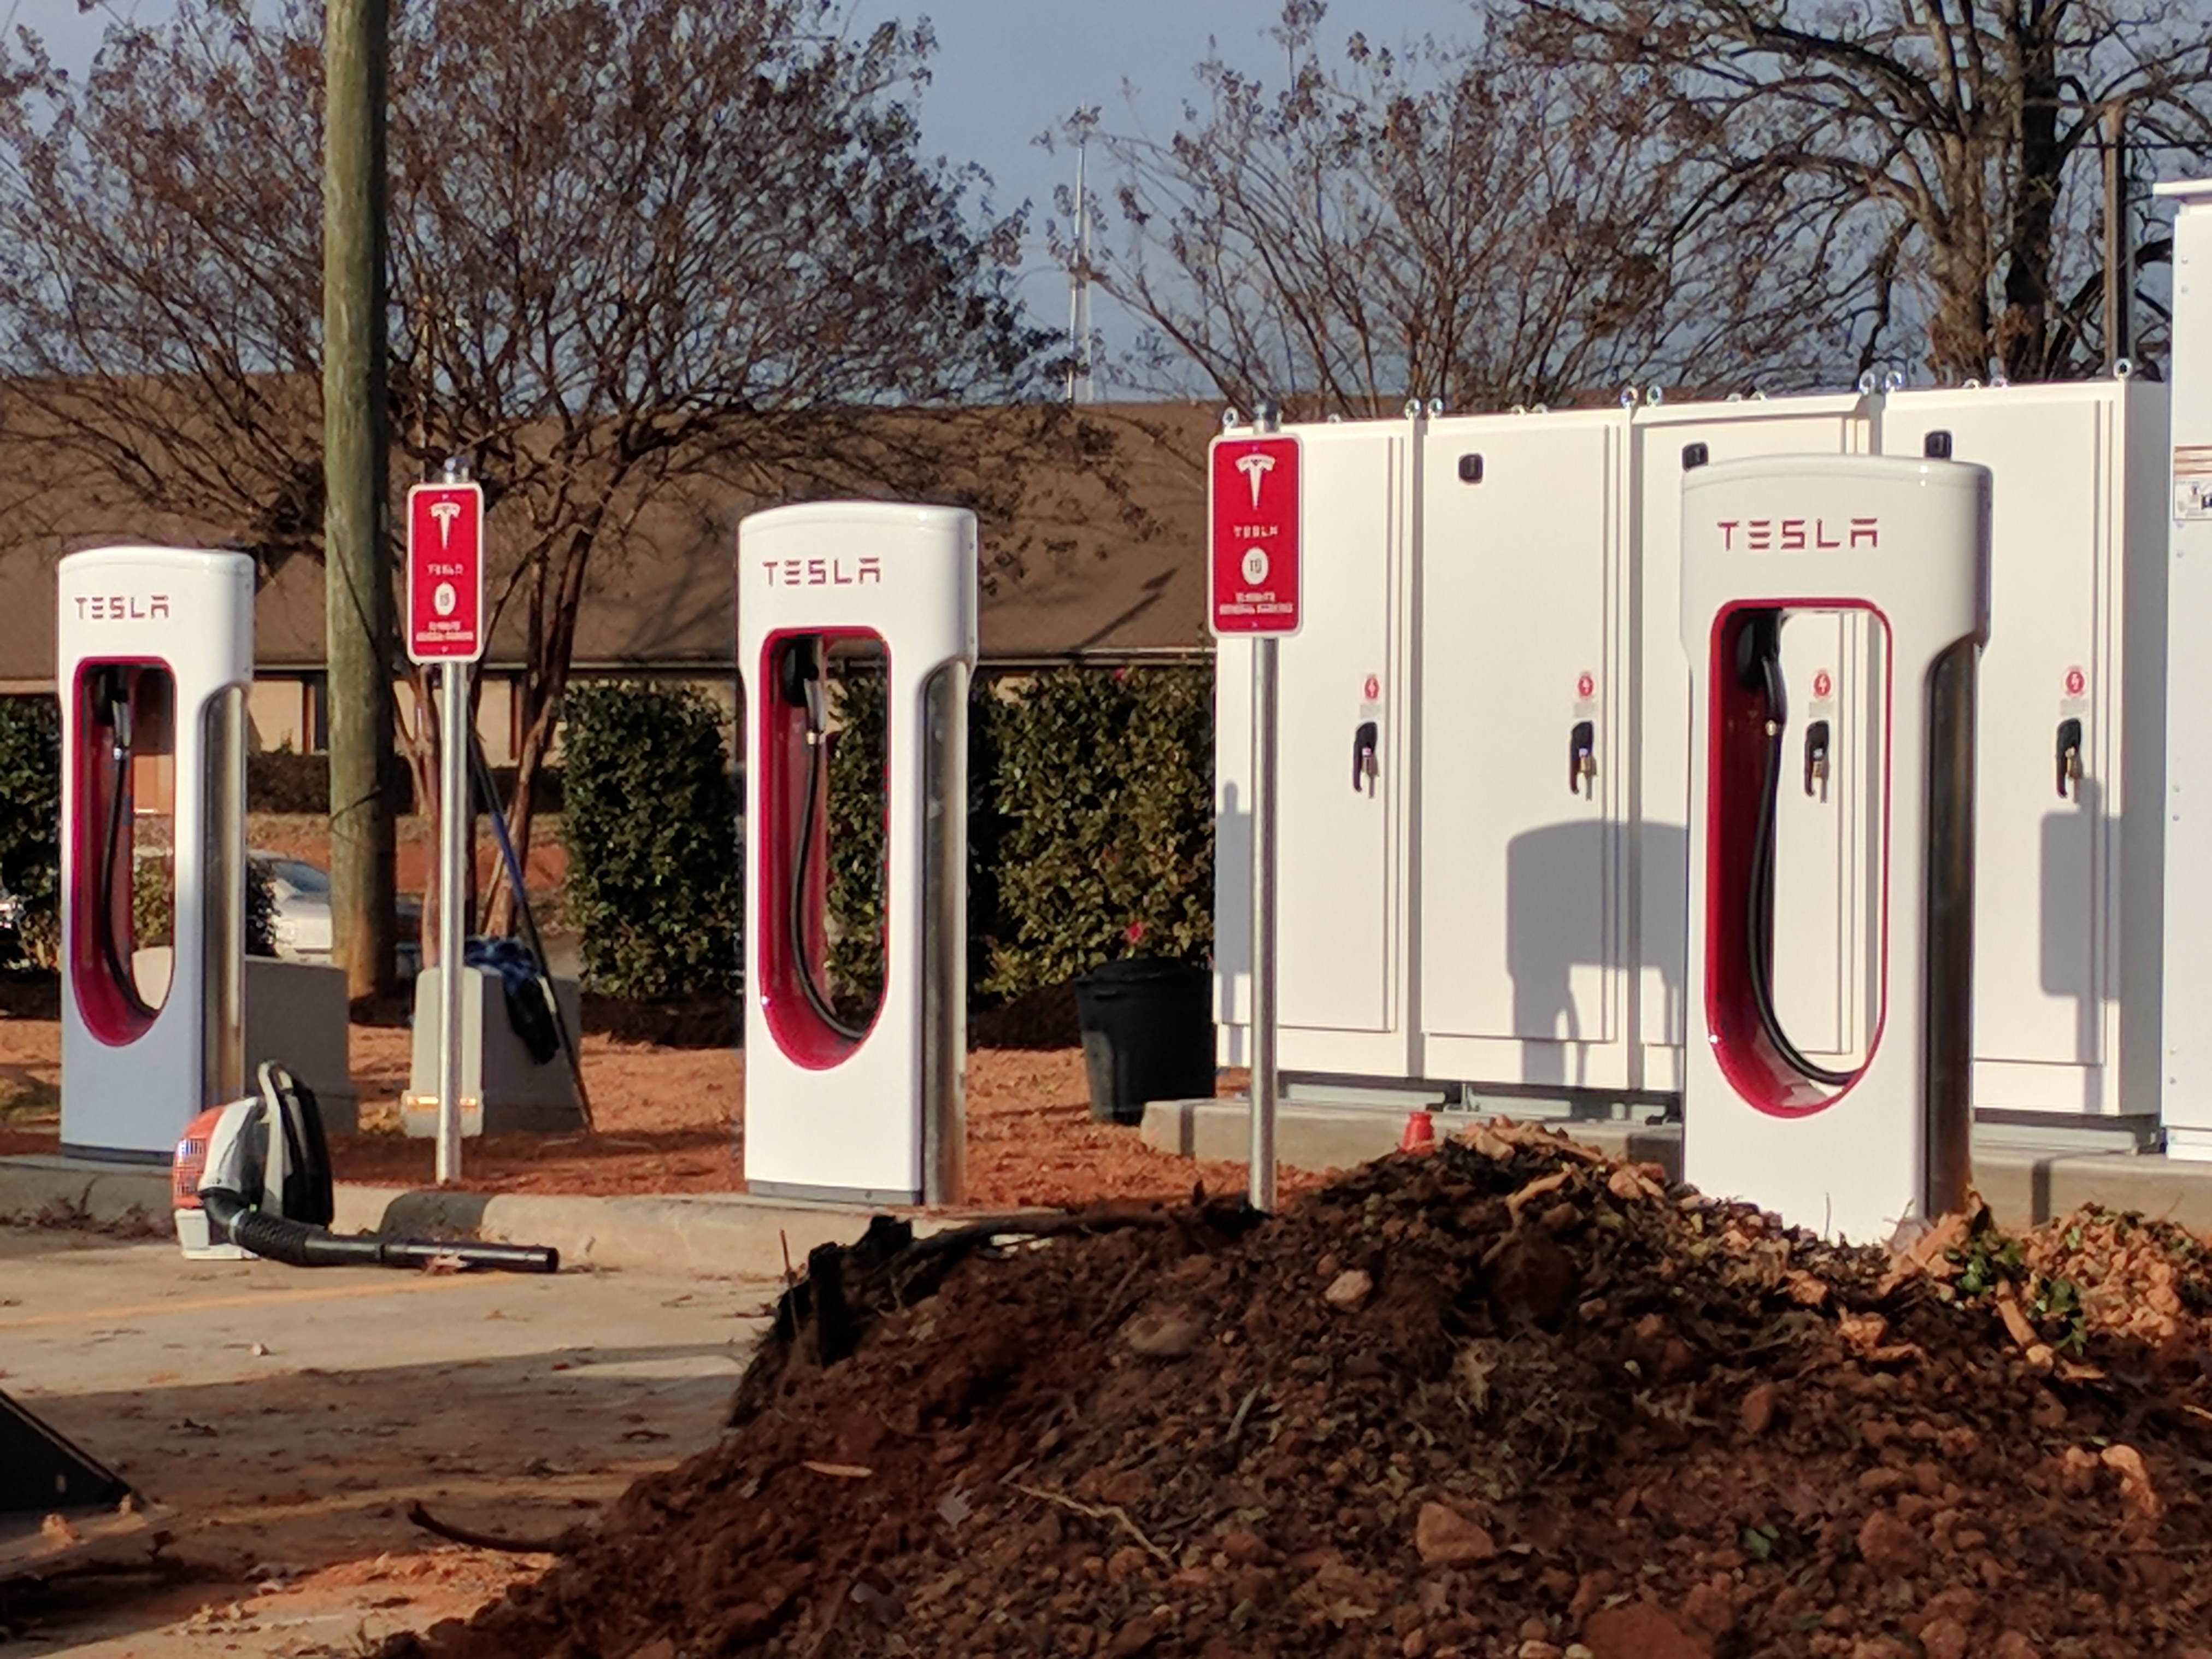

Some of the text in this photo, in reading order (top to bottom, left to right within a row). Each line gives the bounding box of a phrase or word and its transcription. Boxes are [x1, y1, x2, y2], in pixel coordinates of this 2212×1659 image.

[1717, 517, 1878, 551] TESLA
[762, 557, 880, 586] TESLA
[74, 595, 169, 620] TESLA
